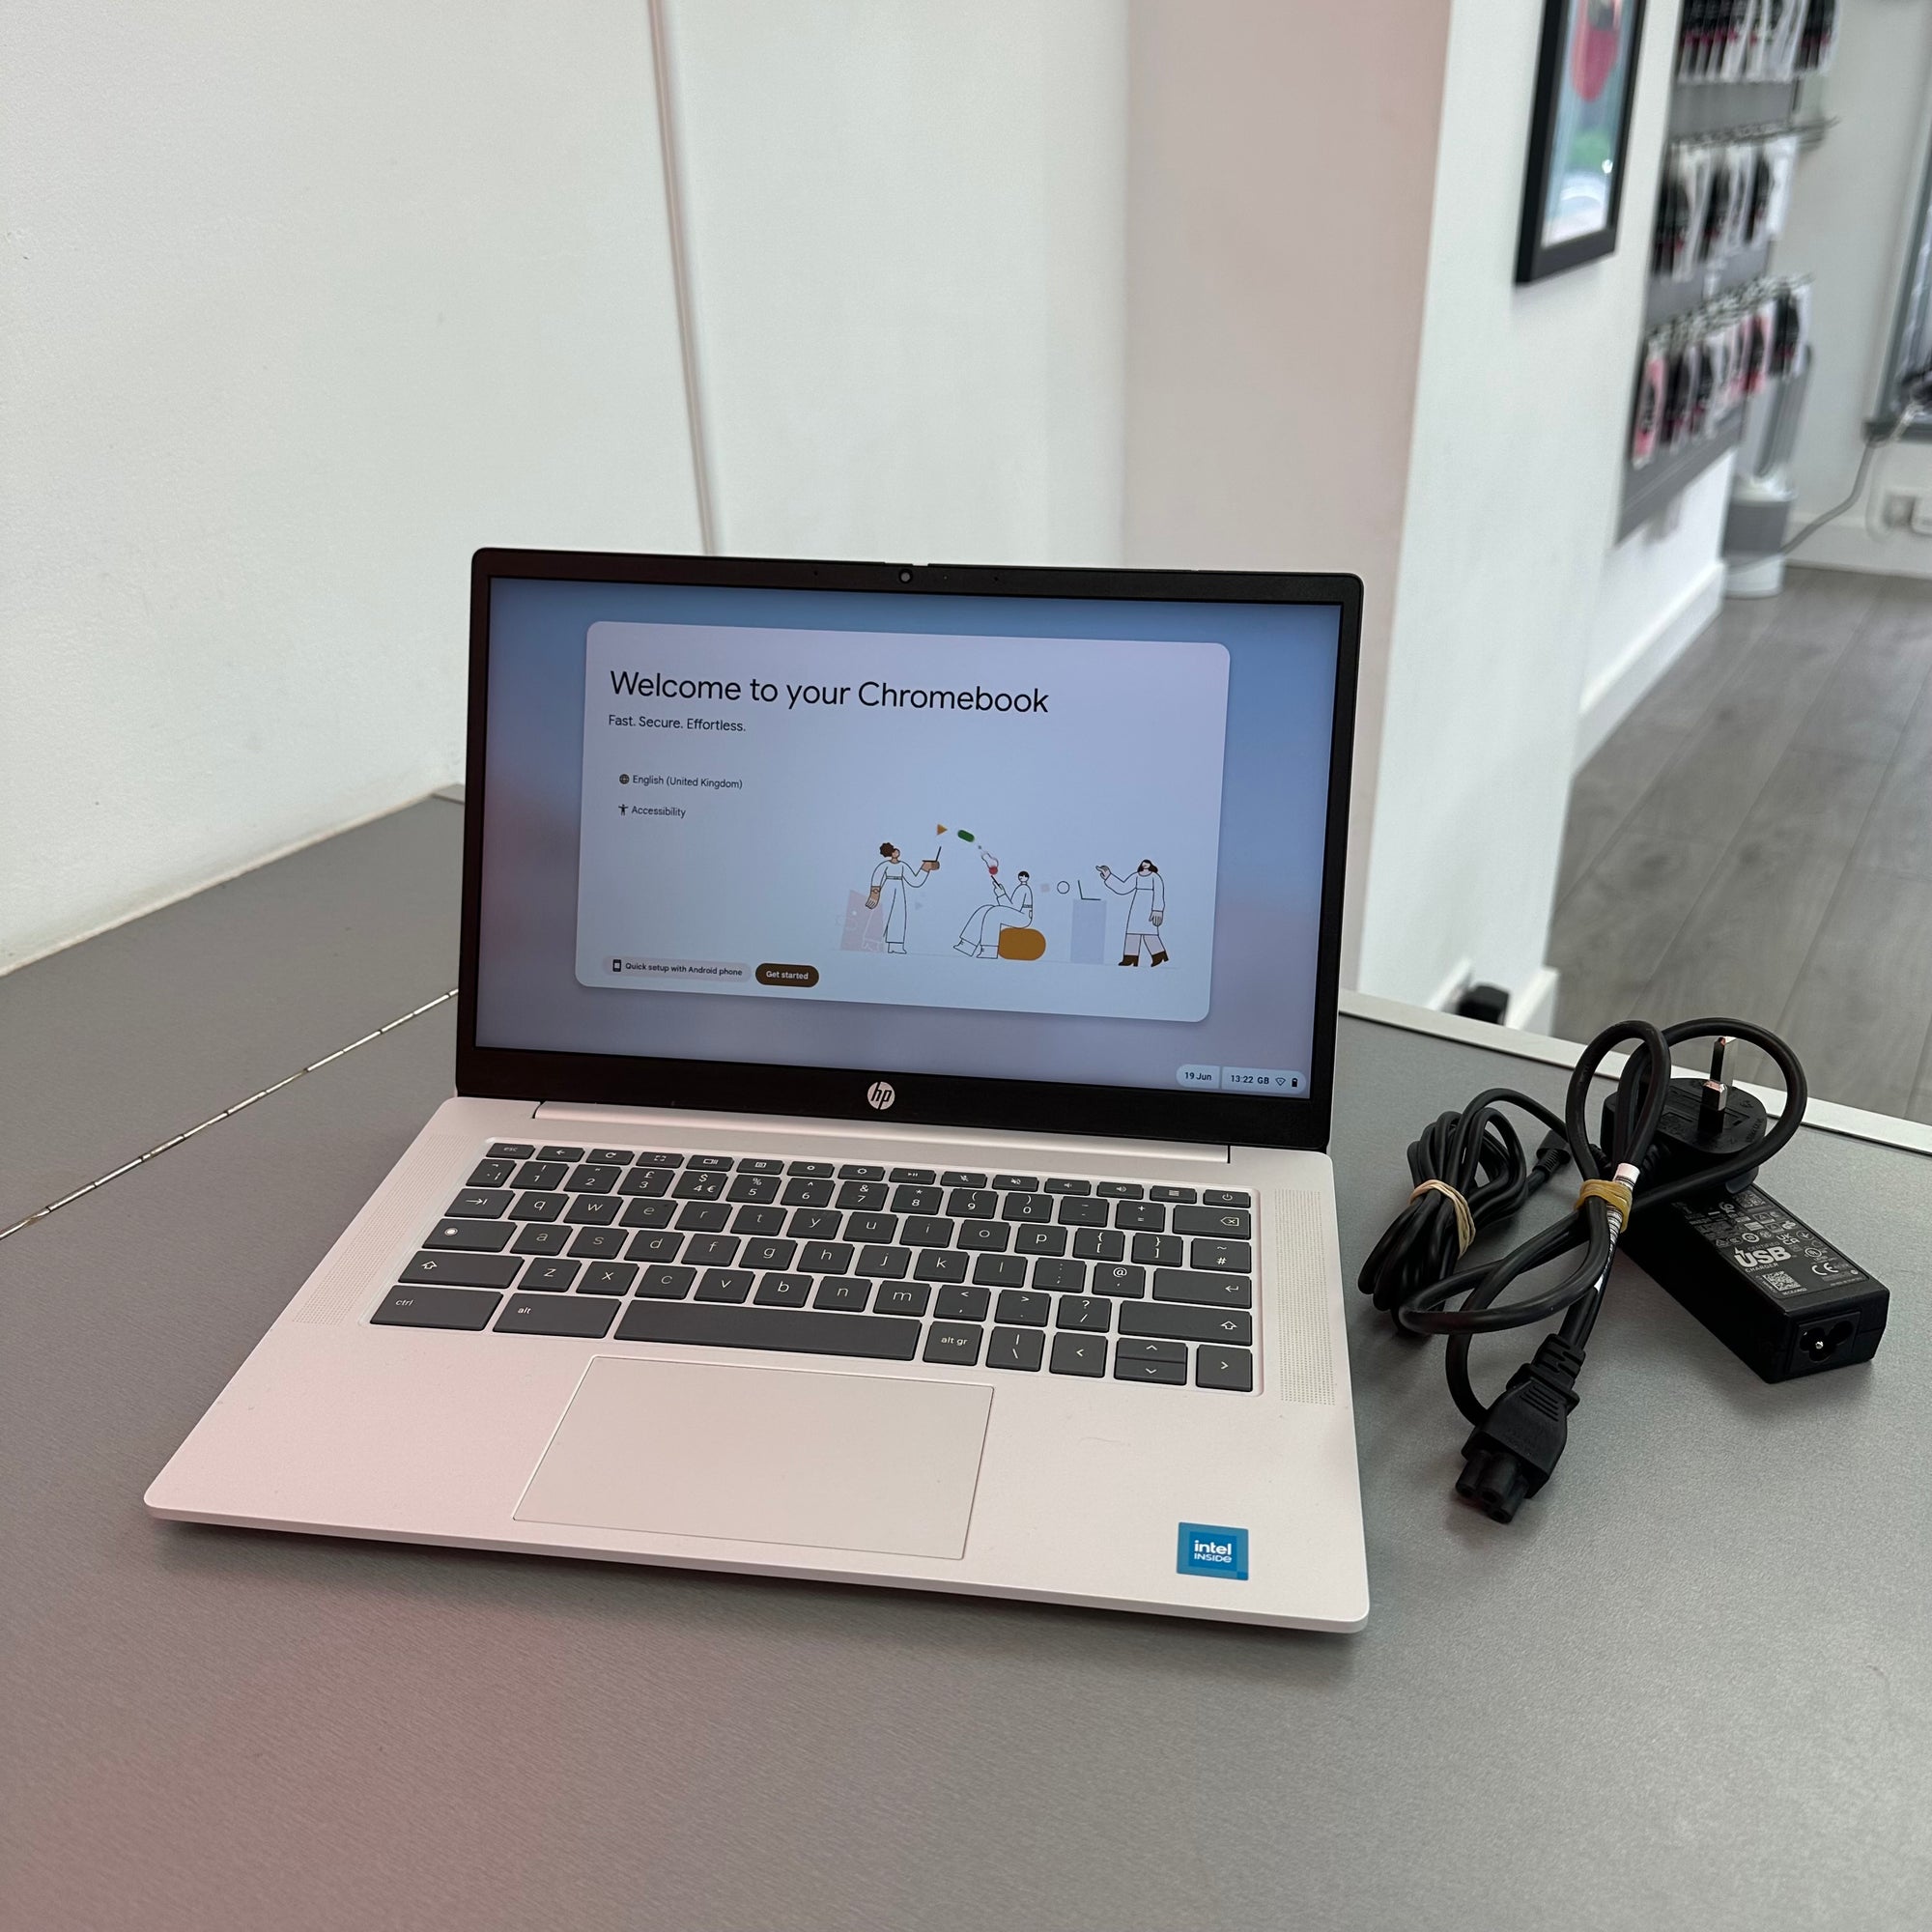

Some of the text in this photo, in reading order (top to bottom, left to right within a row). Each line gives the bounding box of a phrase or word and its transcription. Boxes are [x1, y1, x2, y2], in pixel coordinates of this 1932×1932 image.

[611, 671, 1049, 712] Welcome to your Chromebook
[609, 714, 746, 732] Fast. Secure. Effortless.
[632, 774, 743, 790] English (United Kingdom)
[631, 805, 687, 819] Accessibility
[625, 962, 647, 971] Quick
[647, 964, 670, 974] setup
[688, 966, 718, 975] Android
[719, 967, 743, 977] phone
[765, 970, 810, 980] Get started
[1184, 1071, 1212, 1081] 19 Jun
[1231, 1074, 1269, 1085] 13:22 GB
[869, 1082, 894, 1110] hp
[584, 1178, 596, 1186] 2
[639, 1180, 649, 1189] 3
[857, 1194, 867, 1203] 7
[911, 1198, 921, 1207] 8
[533, 1200, 547, 1211] q
[587, 1203, 604, 1211] w
[967, 1202, 976, 1210] 9
[642, 1207, 655, 1215] e
[699, 1210, 709, 1219] r
[756, 1214, 763, 1224] t
[810, 1217, 821, 1229] y
[866, 1221, 877, 1230] u
[925, 1223, 931, 1234] i
[535, 1233, 549, 1242] a
[979, 1229, 991, 1238] o
[592, 1236, 605, 1245] s
[649, 1237, 664, 1249] d
[1036, 1234, 1047, 1244] p
[709, 1241, 719, 1253] f
[763, 1247, 776, 1259] g
[820, 1249, 833, 1261] h
[1734, 1246, 1792, 1267] USB
[880, 1253, 890, 1266] j
[936, 1257, 947, 1268] k
[543, 1268, 556, 1277] z
[1745, 1262, 1779, 1273] CHARGER
[1811, 1262, 1839, 1276] CE
[601, 1271, 614, 1281] x
[661, 1275, 673, 1285] c
[721, 1280, 732, 1289] v
[777, 1280, 790, 1293] b
[837, 1288, 849, 1297] n
[893, 1292, 912, 1302] m
[517, 1306, 531, 1315] alt
[941, 1336, 968, 1347] alt gr
[1194, 1539, 1233, 1555] intel
